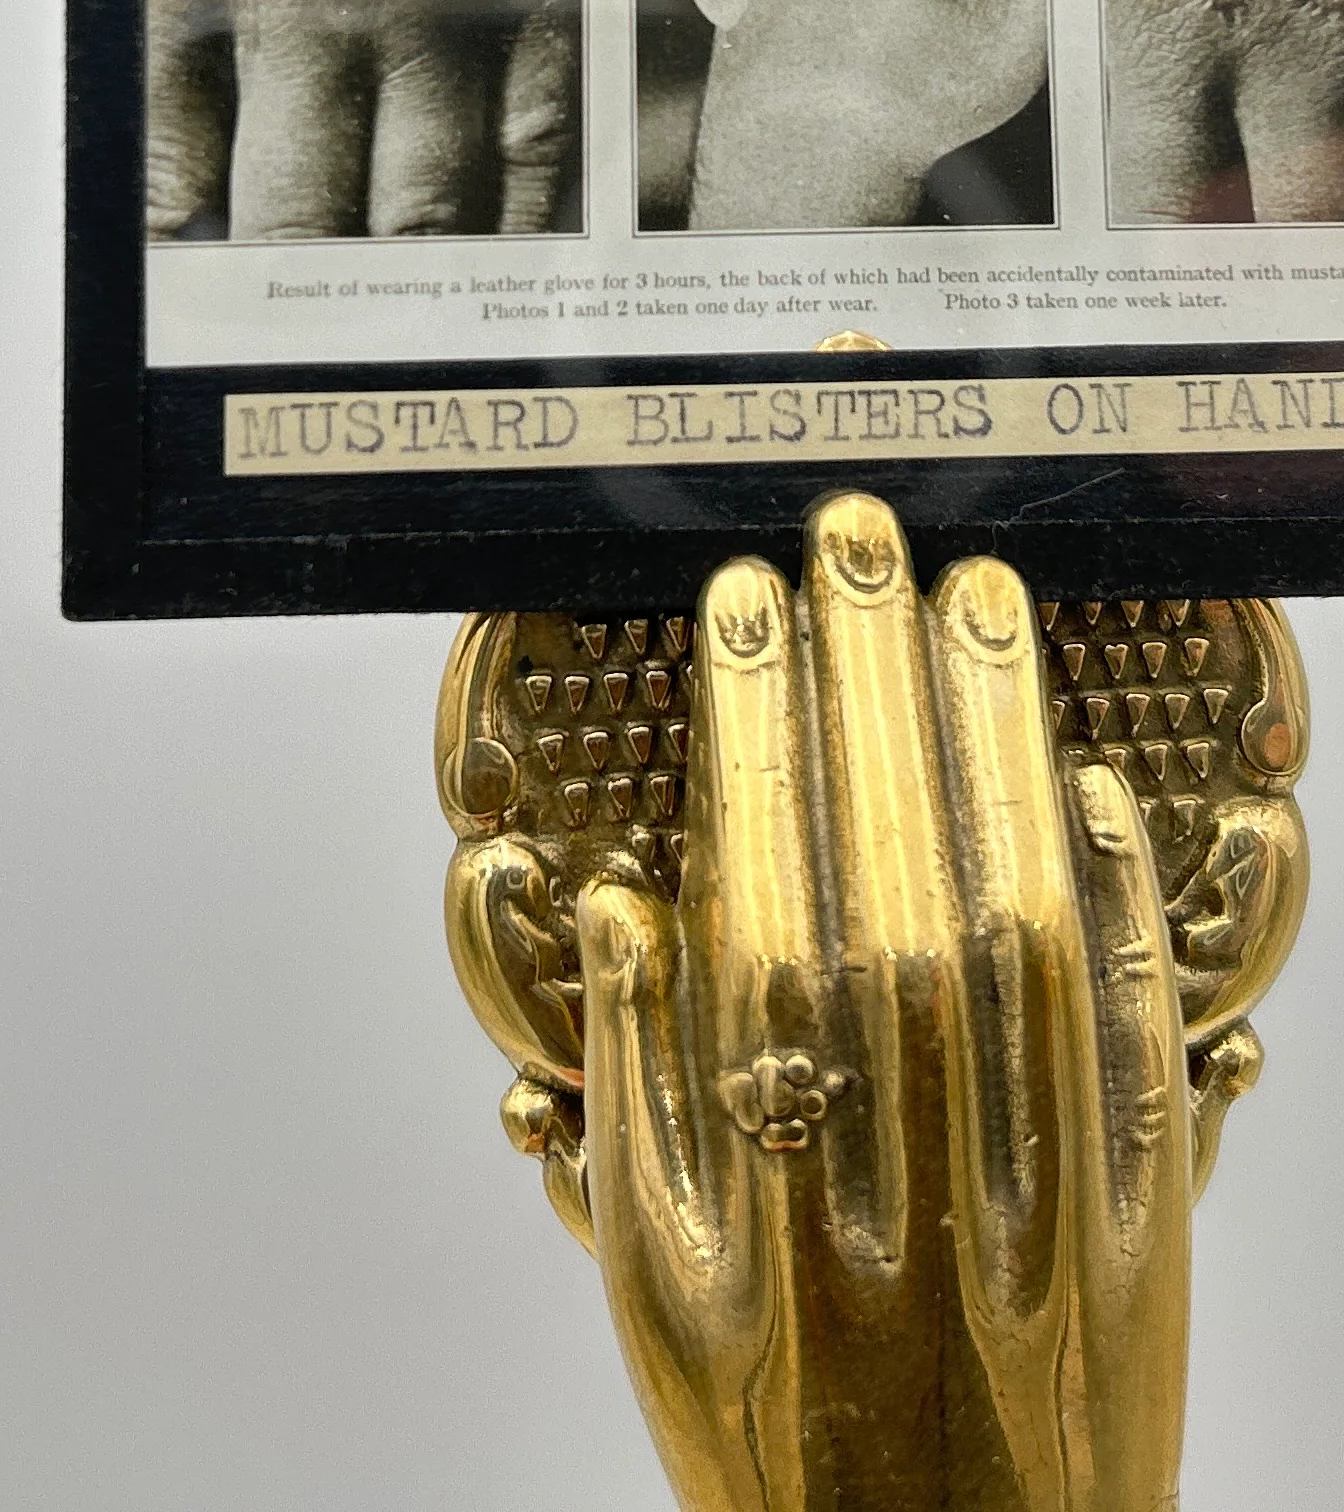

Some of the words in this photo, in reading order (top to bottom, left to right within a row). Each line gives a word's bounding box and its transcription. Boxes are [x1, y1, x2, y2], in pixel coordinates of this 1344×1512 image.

[267, 280, 331, 299] Result
[337, 280, 358, 296] of
[366, 279, 444, 299] wearing
[451, 281, 462, 294] a
[470, 276, 537, 294] leather
[544, 274, 594, 295] glove
[603, 273, 629, 289] for
[636, 273, 648, 289] 3
[653, 271, 712, 289] hours,
[719, 270, 750, 287] the
[757, 269, 802, 286] back
[807, 268, 827, 286] of
[834, 268, 888, 285] which
[897, 267, 931, 284] had
[938, 267, 980, 284] been
[986, 265, 1099, 286] accidentally
[1106, 264, 1234, 282] contaminated
[1242, 263, 1284, 281] with
[482, 302, 549, 320] Photos
[557, 301, 565, 317] 1
[574, 300, 609, 317] and
[616, 299, 629, 316] 2
[636, 298, 689, 316] taken
[695, 300, 729, 315] one
[734, 297, 769, 318] day
[776, 295, 822, 313] after
[829, 298, 879, 312] wear.
[945, 292, 1001, 310] Photo
[1007, 292, 1019, 309] 3
[1026, 292, 1078, 309] taken
[1084, 294, 1118, 308] one
[1125, 291, 1172, 308] week
[1178, 292, 1227, 308] later.
[236, 395, 579, 460] MUSTARD
[624, 383, 994, 446] BLISTERS
[1046, 381, 1134, 436] ON
